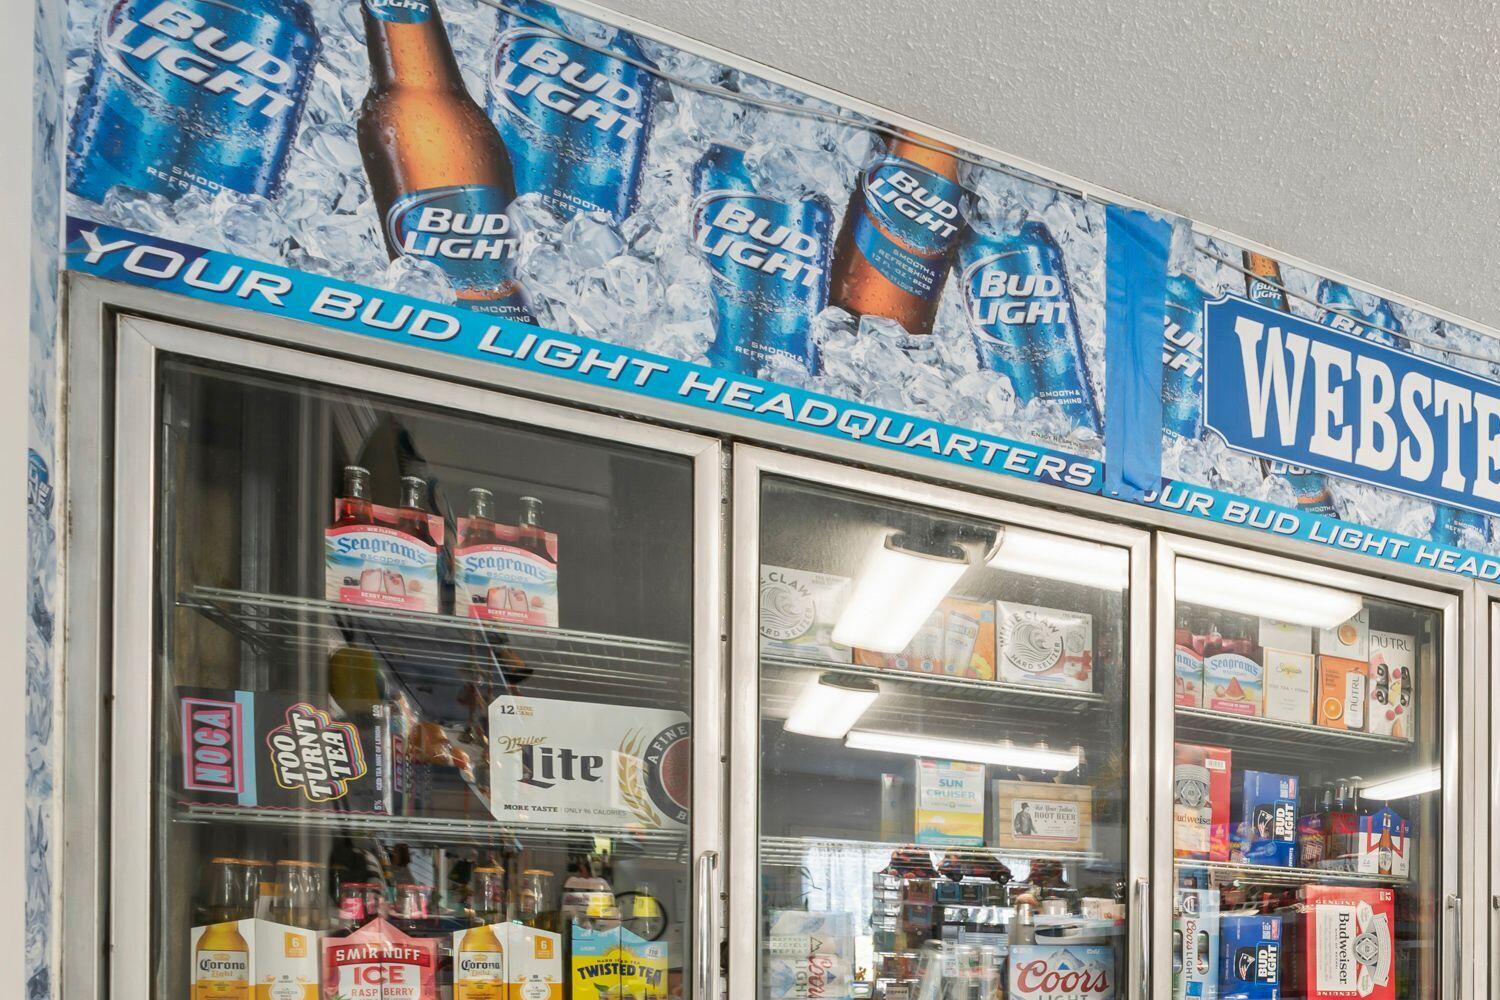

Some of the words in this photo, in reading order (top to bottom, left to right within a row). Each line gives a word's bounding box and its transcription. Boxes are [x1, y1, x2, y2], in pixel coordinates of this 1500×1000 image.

[138, 0, 296, 86] BUD
[106, 21, 298, 119] LIGHT
[521, 39, 638, 109] BUD
[498, 59, 644, 140] LIGHT
[888, 168, 959, 219] BUD
[418, 206, 511, 236] BUD
[867, 178, 959, 241] LIGHT
[402, 231, 518, 260] LIGHT
[711, 201, 820, 259] BUD
[702, 227, 825, 287] LIGHT
[980, 271, 1060, 297] BUD
[974, 301, 1070, 325] LIGHT
[79, 230, 295, 306] YOUR
[309, 293, 460, 340] BUD
[478, 325, 669, 388] LIGHT
[678, 362, 1098, 488] HEADQUARTERS
[1222, 501, 1300, 536] BUD
[1308, 523, 1411, 563] LIGHT
[336, 536, 427, 566] Seagram's
[465, 556, 548, 581] Seagram's
[500, 705, 515, 714] 12
[193, 709, 232, 784] NOCA
[273, 735, 304, 785] TOO
[292, 713, 332, 798] TURNT
[322, 731, 352, 778] TEA
[498, 736, 547, 754] Miller
[517, 745, 603, 789] Lite
[927, 789, 976, 799] CRUISER
[938, 779, 964, 788] SUN
[1034, 812, 1056, 820] ROOT
[1058, 812, 1076, 820] BEER
[336, 947, 421, 962] SMIRNOFF
[1338, 912, 1348, 984] Budweiser
[200, 960, 246, 971] Corona
[354, 966, 405, 985] ICE
[461, 960, 500, 970] Corona
[577, 964, 636, 979] TWISTED
[639, 968, 662, 985] TEA
[1017, 960, 1110, 992] Coors
[1258, 950, 1268, 978] BUD
[1267, 945, 1278, 983] LIGHT
[351, 987, 414, 996] RASPBERRY
